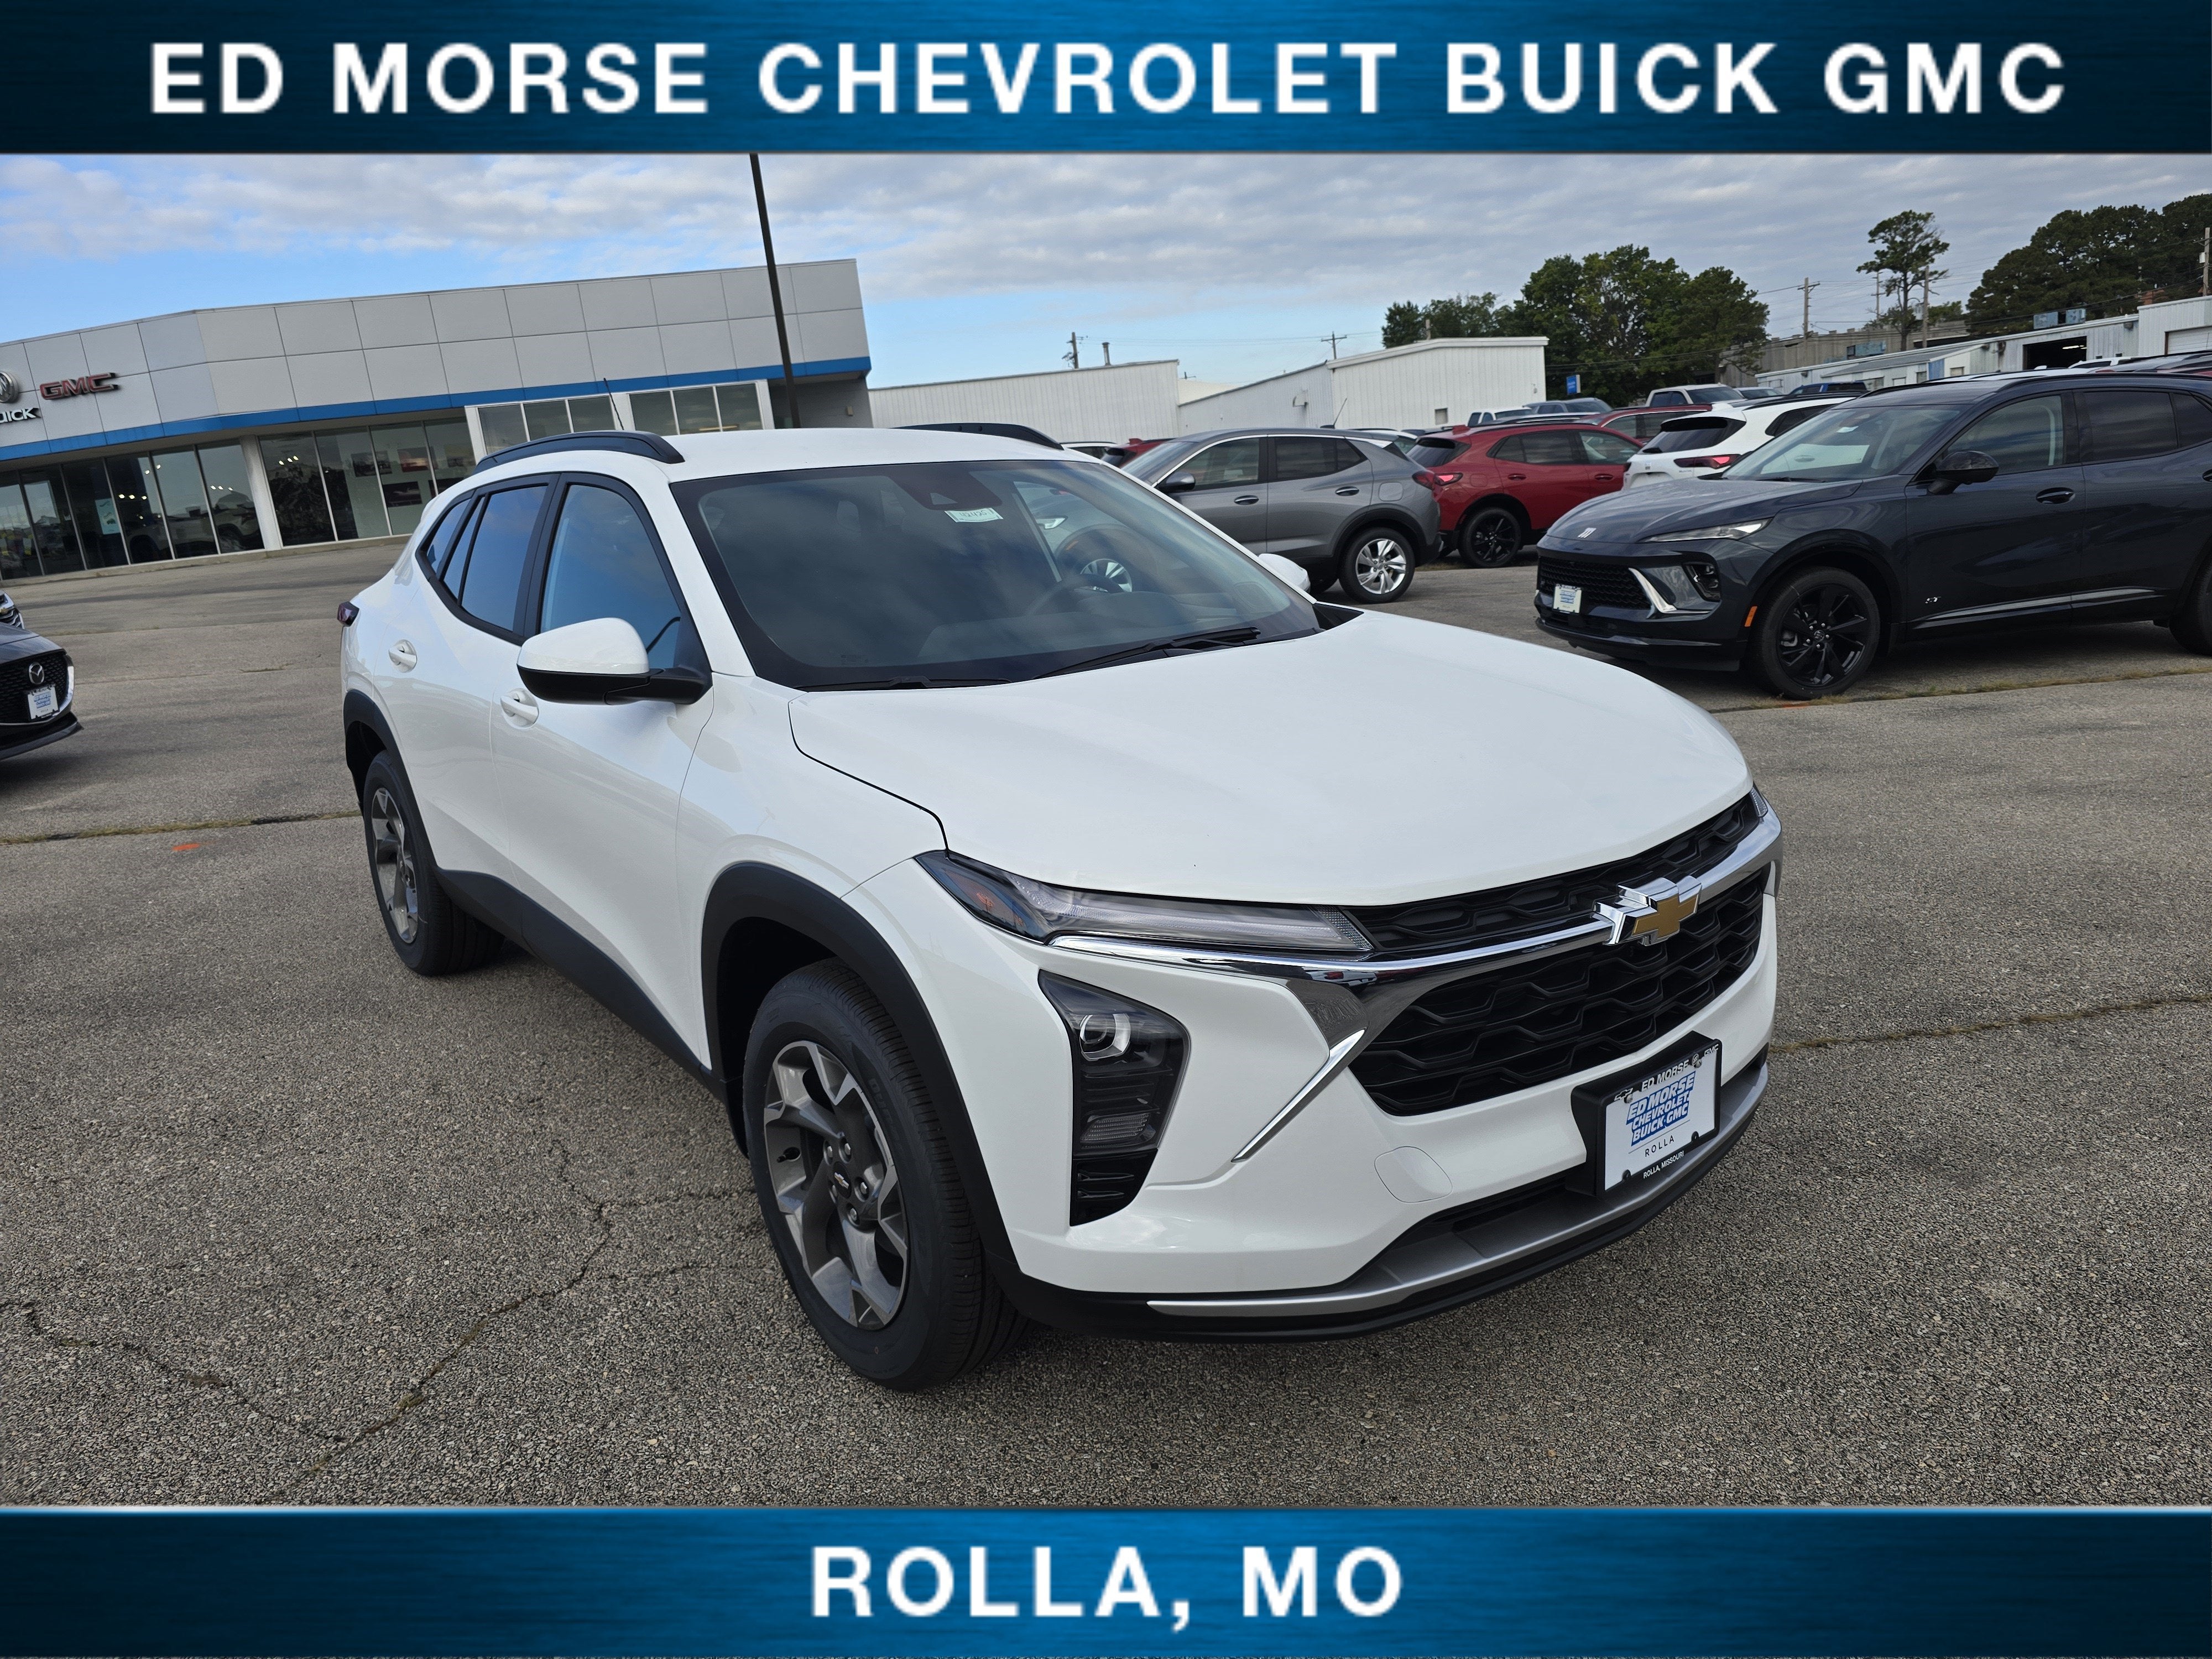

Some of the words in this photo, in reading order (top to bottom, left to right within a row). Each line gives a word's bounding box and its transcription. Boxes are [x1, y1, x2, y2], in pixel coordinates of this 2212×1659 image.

[40, 372, 114, 400] GMC
[0, 408, 36, 424] UICK
[1704, 1044, 1719, 1057] GMC
[1641, 1077, 1655, 1092] ED
[1657, 1060, 1689, 1085] MORSE
[1627, 1098, 1647, 1120] ED
[1647, 1072, 1695, 1111] MORSE
[1632, 1090, 1689, 1130] CHEVROLET
[1633, 1115, 1665, 1143] BUICK
[1666, 1102, 1688, 1124] GMC
[1645, 1135, 1674, 1157] ROLLA
[1643, 1165, 1661, 1179] ROLLA,
[1661, 1150, 1684, 1169] MISSOURI
